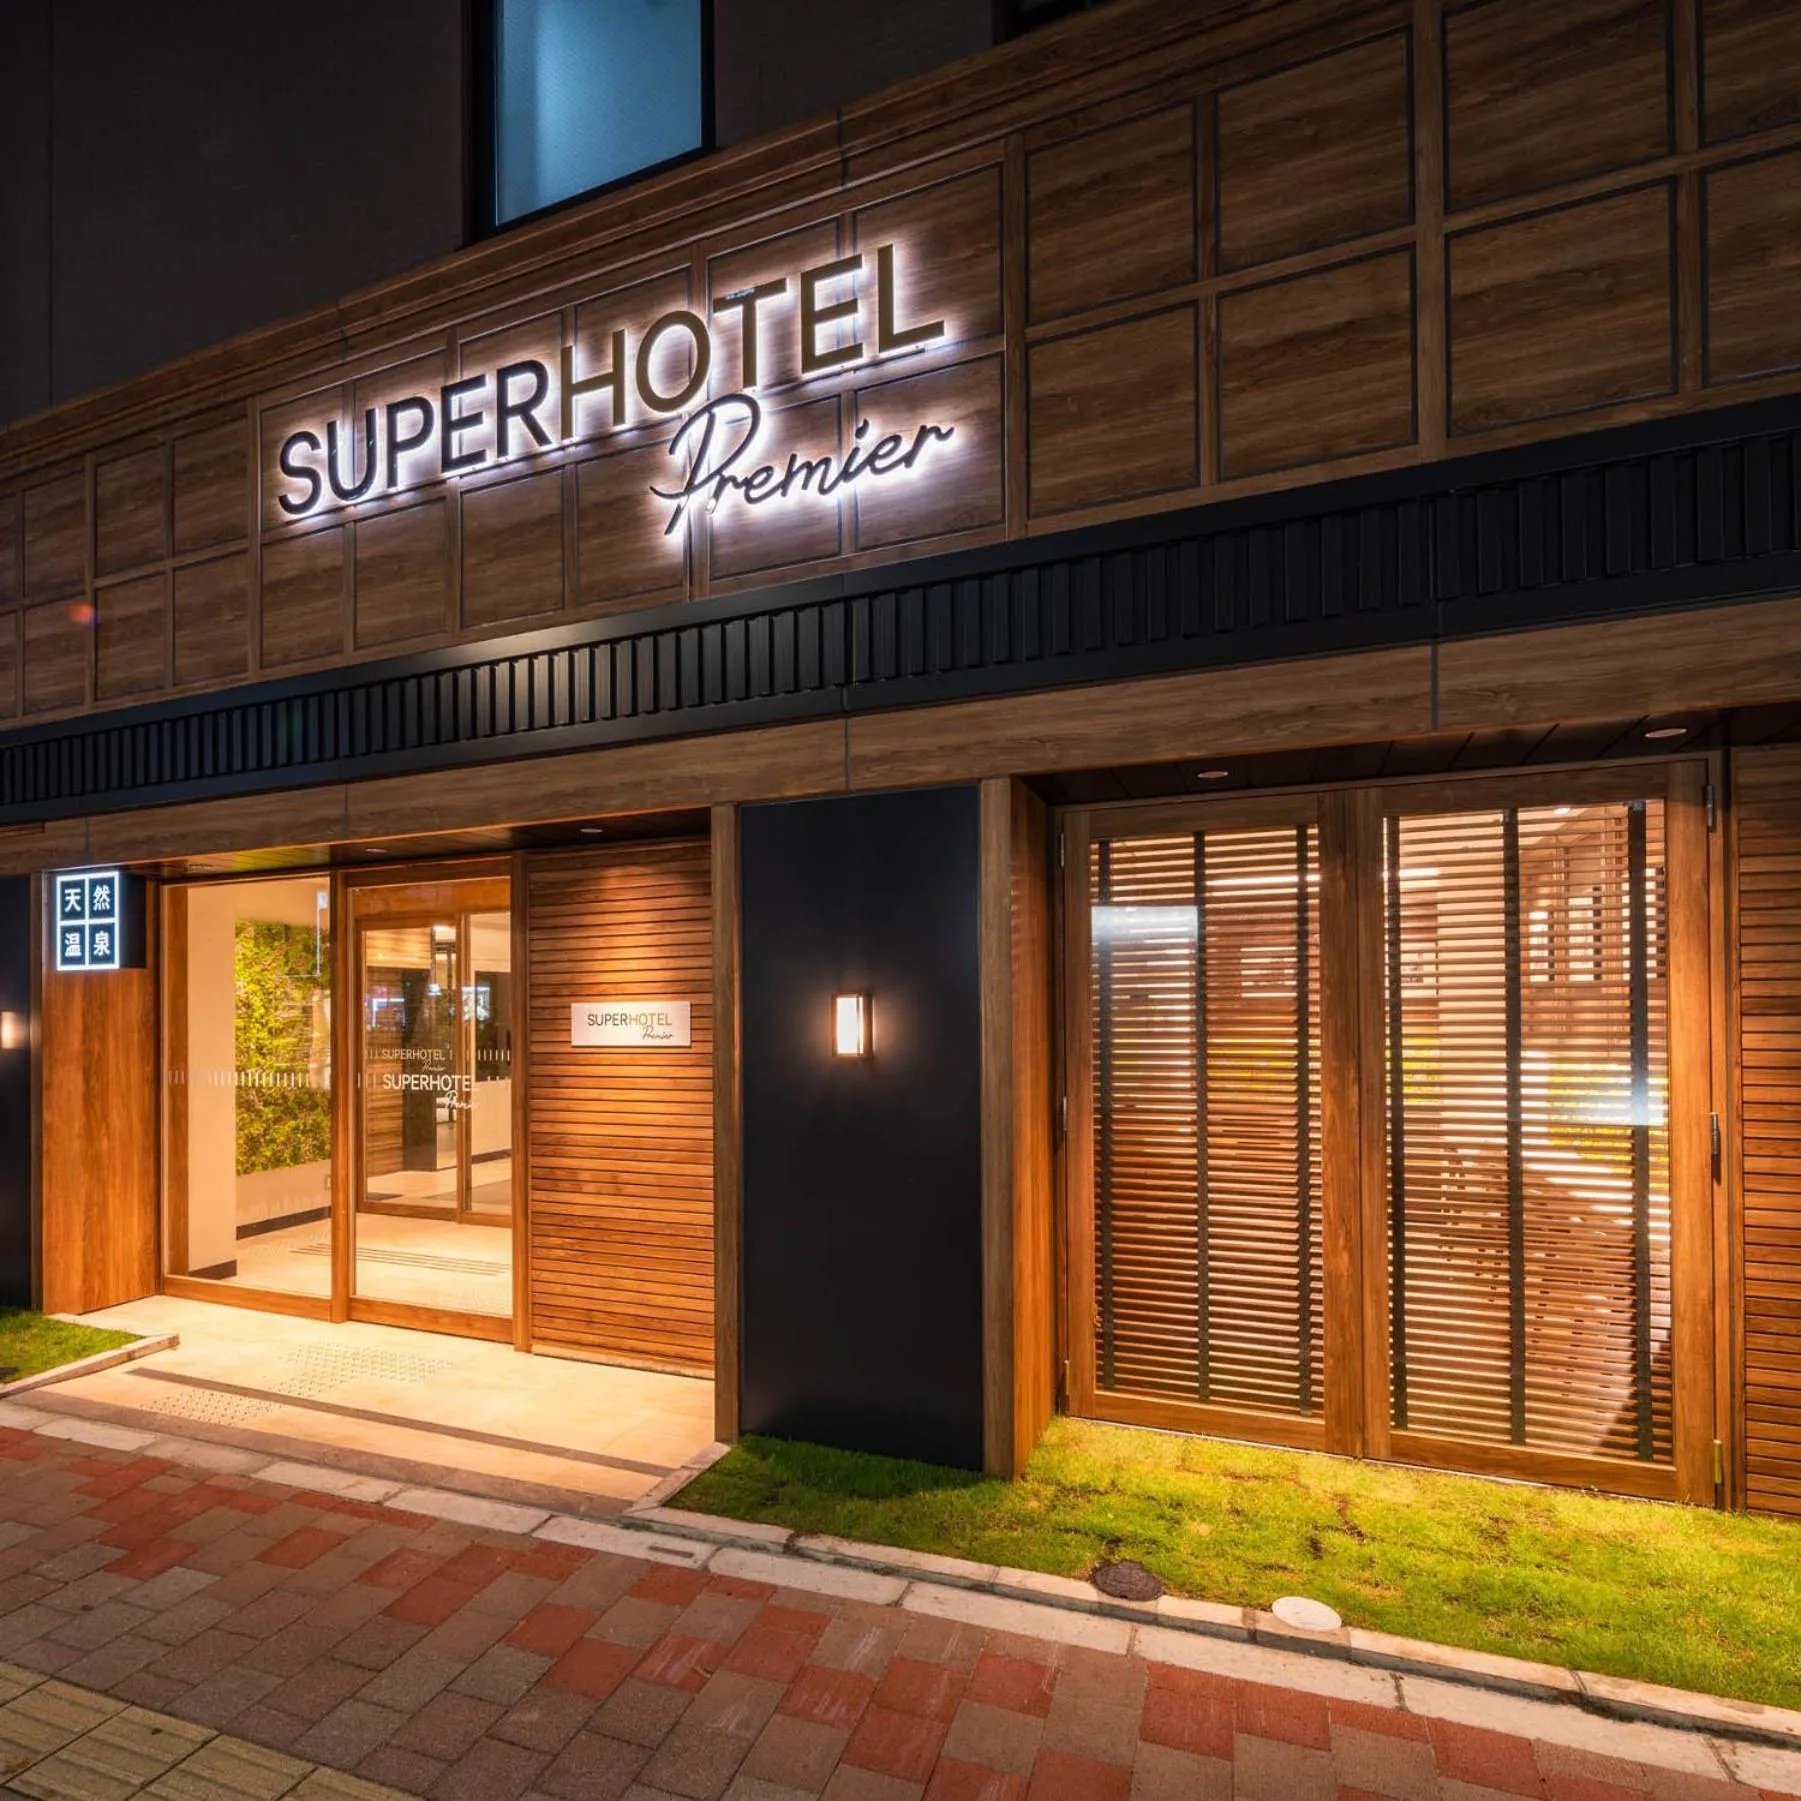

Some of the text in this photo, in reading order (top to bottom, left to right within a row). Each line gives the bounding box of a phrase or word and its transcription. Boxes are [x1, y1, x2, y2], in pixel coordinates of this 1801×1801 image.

[279, 244, 946, 516] SUPERHOTEL
[650, 393, 955, 536] Premier
[64, 884, 111, 912] 天然
[64, 930, 111, 957] 温泉
[587, 1013, 672, 1026] SUPERHOTEL
[642, 1025, 673, 1040] Premier
[382, 1048, 445, 1060] SUPERHOTEL
